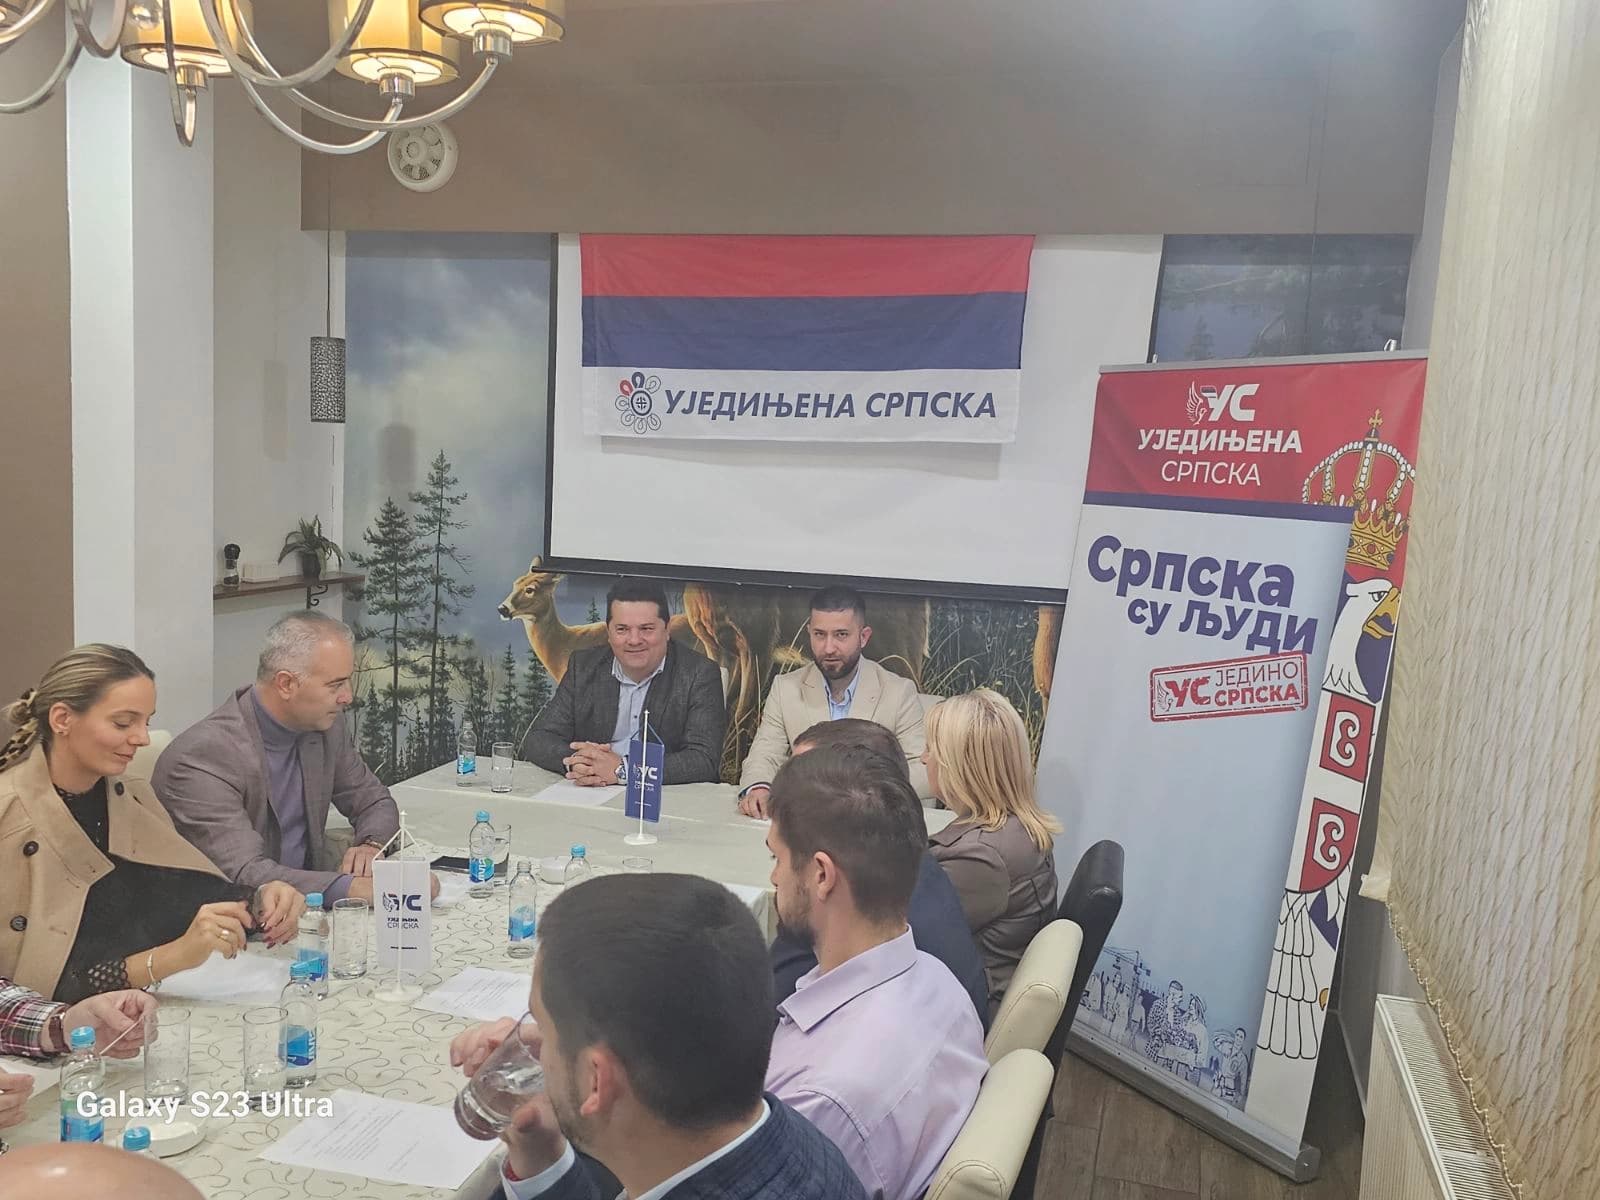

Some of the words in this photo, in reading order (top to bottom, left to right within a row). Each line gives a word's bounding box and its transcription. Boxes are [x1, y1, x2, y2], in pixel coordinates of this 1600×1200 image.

[664, 388, 857, 420] УЈЕДИЊЕНА
[865, 391, 997, 419] СРПСКА
[1200, 384, 1260, 422] УС
[1137, 428, 1303, 455] УЈЕДИЊЕНА
[1160, 460, 1261, 487] СРПСКА
[1087, 534, 1295, 609] Српска
[1127, 597, 1172, 636] су
[1215, 661, 1299, 687] ЈЕДИНО
[1164, 676, 1211, 708] УС
[1214, 683, 1300, 707] СРПСКА
